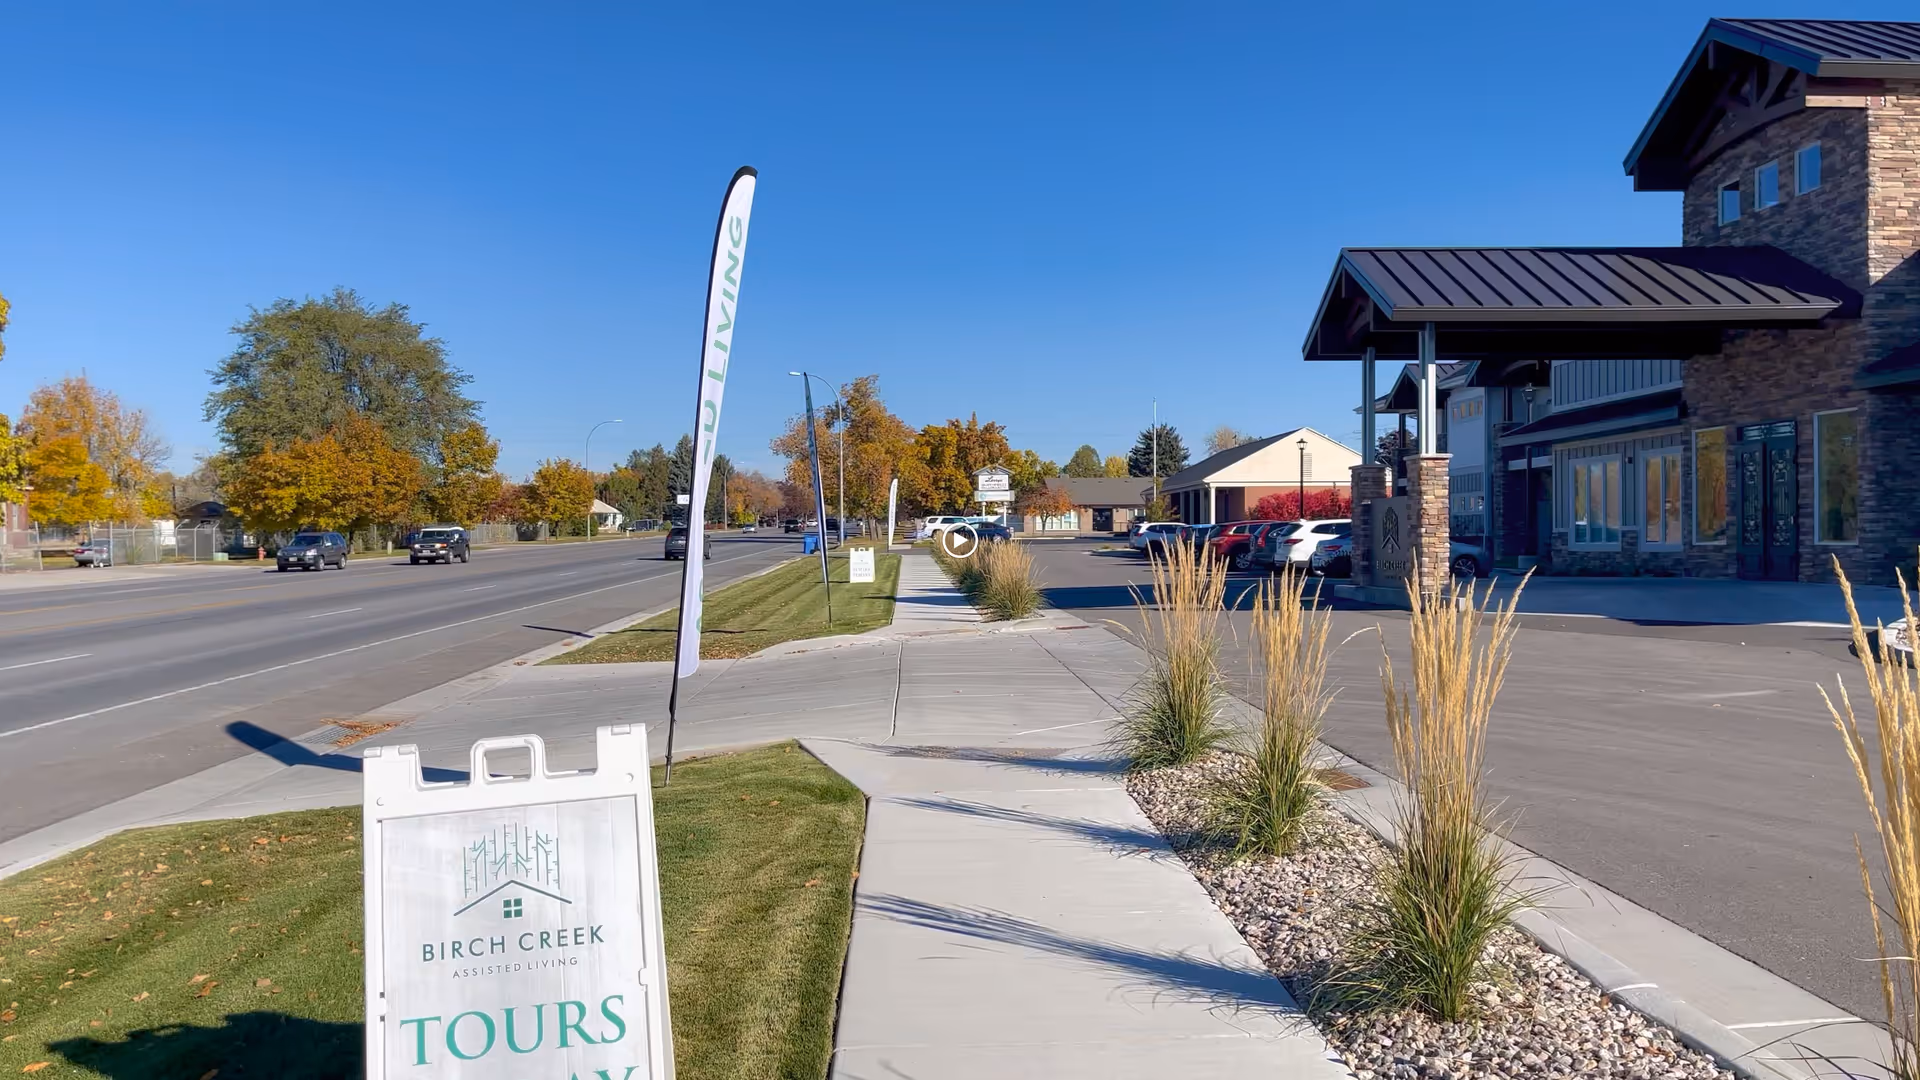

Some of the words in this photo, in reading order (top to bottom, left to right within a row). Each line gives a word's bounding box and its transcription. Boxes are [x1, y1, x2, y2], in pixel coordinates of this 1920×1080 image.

[707, 215, 743, 383] LIVING
[422, 935, 506, 962] BIRCH
[518, 924, 605, 951] CREEK
[452, 963, 522, 979] ASSISTED
[527, 957, 579, 971] LIVING
[400, 994, 627, 1067] TOURS
